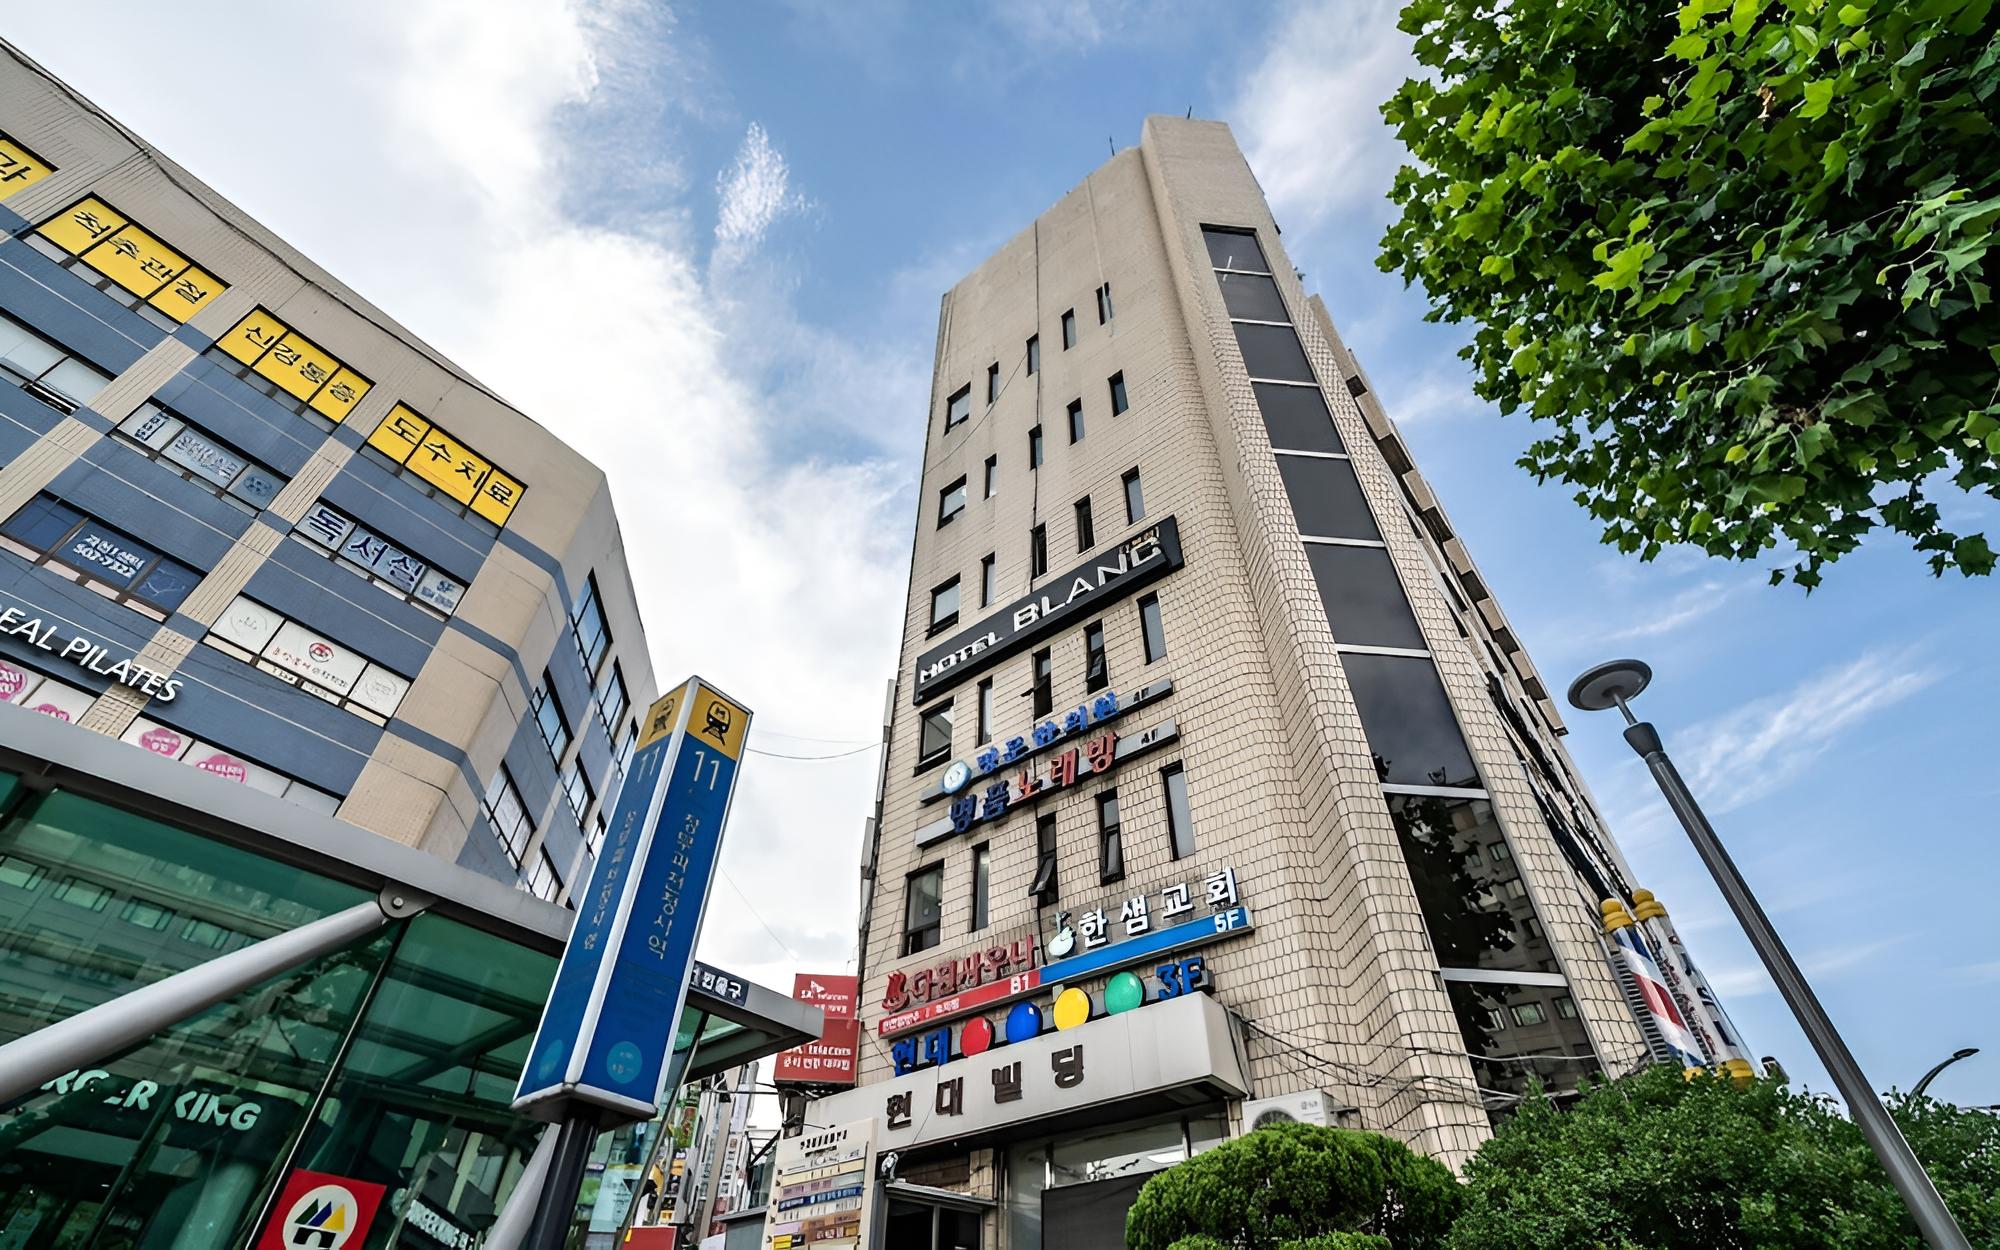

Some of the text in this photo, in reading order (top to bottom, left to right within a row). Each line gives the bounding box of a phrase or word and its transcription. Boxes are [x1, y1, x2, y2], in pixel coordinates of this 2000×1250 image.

[386, 416, 510, 508] 도수치료
[309, 508, 424, 592] 독서실
[0, 606, 57, 651] EAL
[60, 636, 184, 702] PILATES
[919, 631, 1004, 684] HOTEL
[694, 750, 720, 791] 11
[949, 730, 1120, 834] 명품노래방
[1078, 866, 1240, 948] 한샘교회
[1010, 974, 1029, 994] B1
[1155, 956, 1207, 1001] 3F
[886, 1044, 1085, 1131] 현대빌딩
